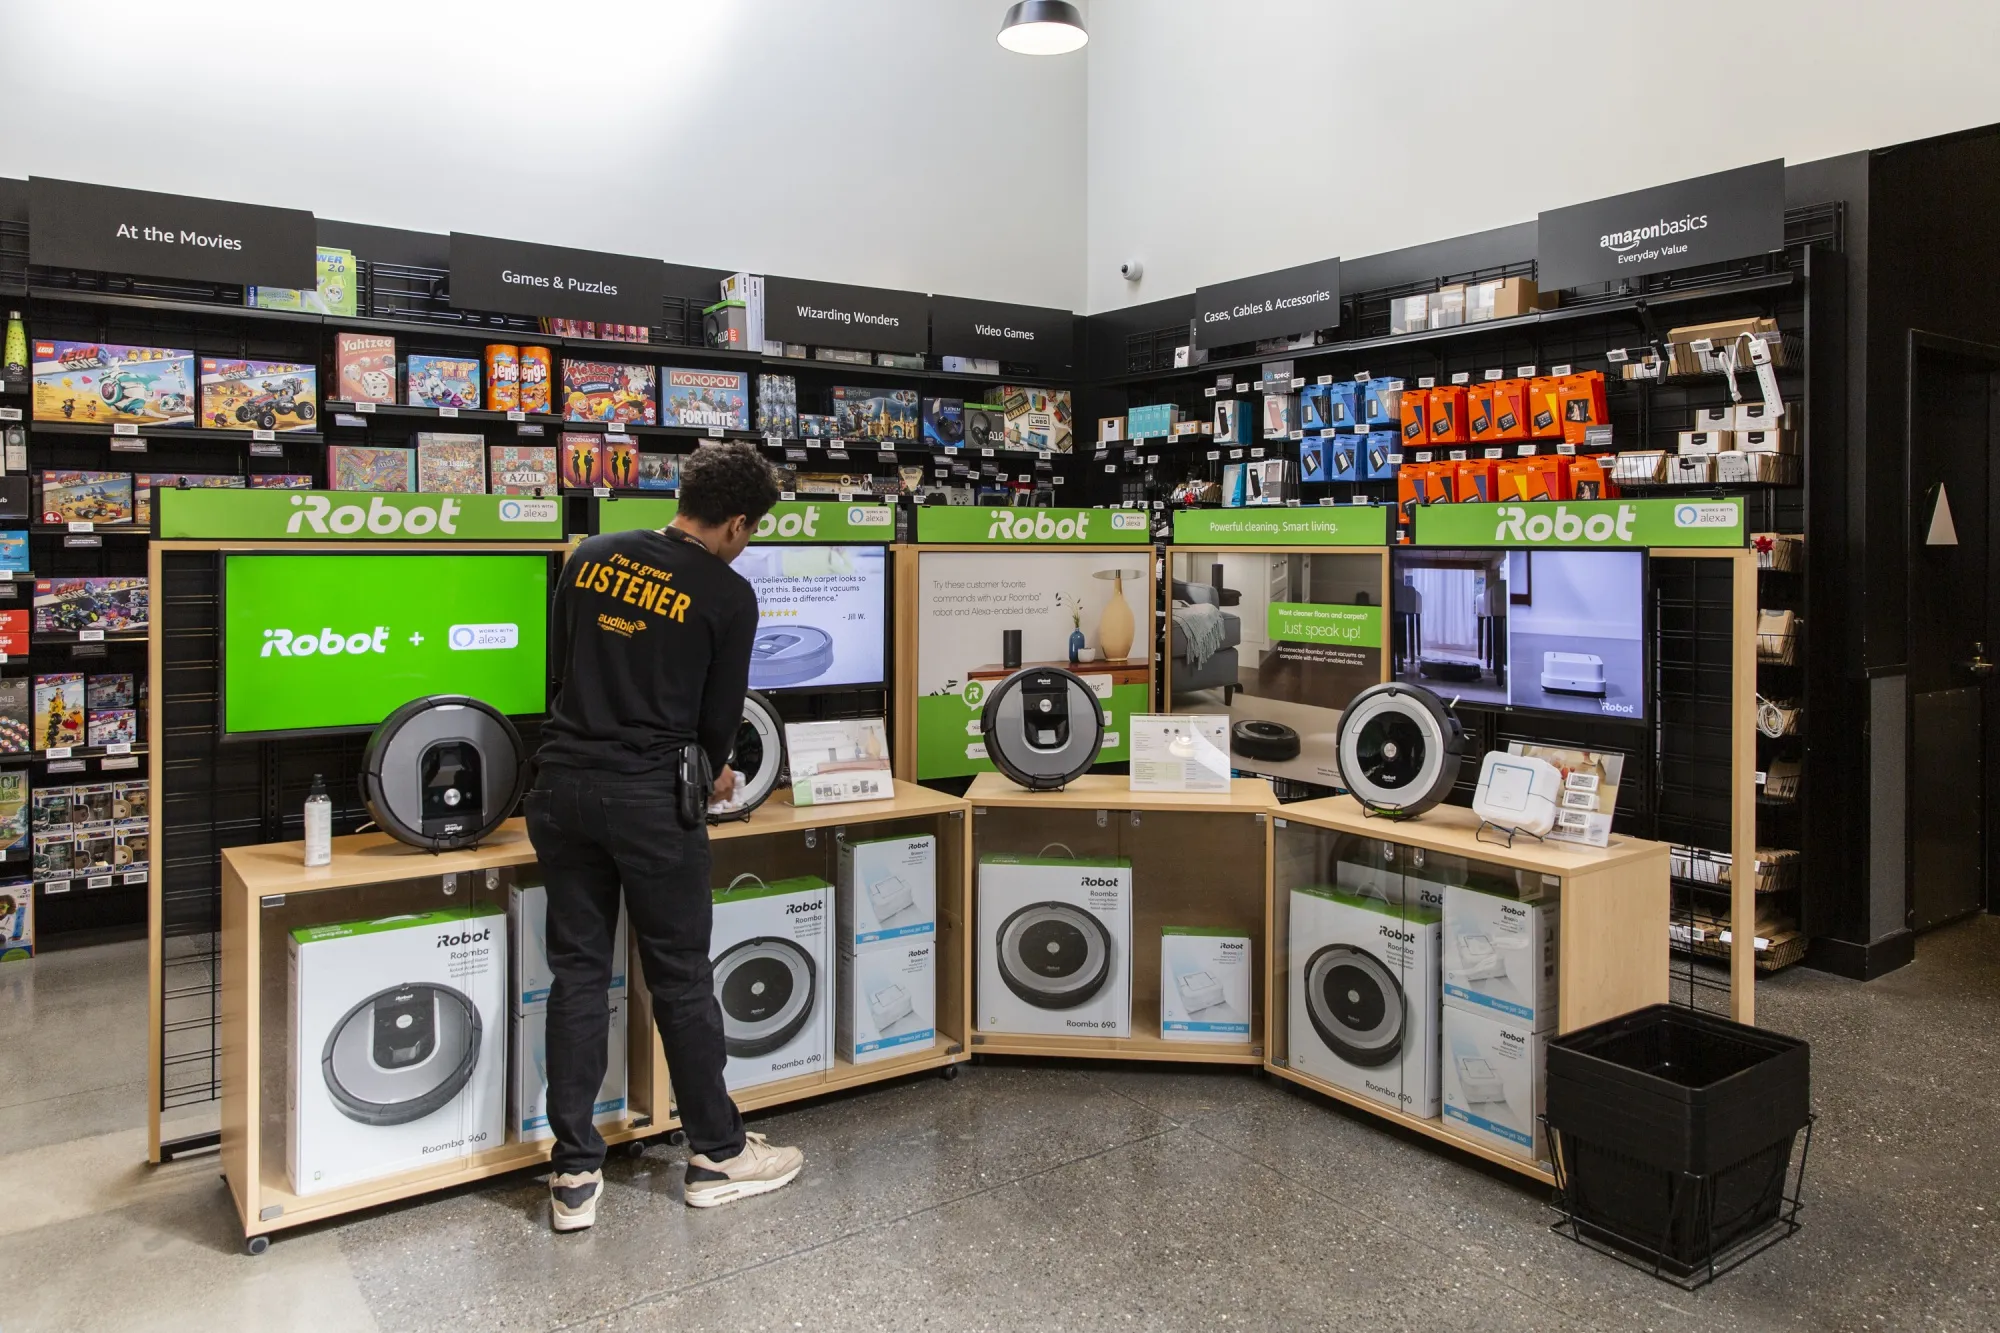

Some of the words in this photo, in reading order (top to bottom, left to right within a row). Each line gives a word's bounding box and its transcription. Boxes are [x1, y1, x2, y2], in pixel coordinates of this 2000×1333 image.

[116, 223, 139, 240] At
[143, 226, 175, 244] the
[180, 230, 242, 251] Movies
[1600, 214, 1708, 249] amazonbasics
[1618, 249, 1659, 264] Everyday
[1661, 244, 1688, 256] Value
[328, 264, 346, 273] 2.0
[502, 270, 549, 288] Games
[553, 276, 564, 289] &
[568, 278, 618, 296] Puzzles
[1204, 310, 1231, 324] Cases,
[1233, 302, 1263, 318] Cables
[1265, 300, 1273, 311] &
[1275, 289, 1330, 310] Accessories
[797, 305, 851, 325] Wizarding
[854, 312, 900, 327] Wonders
[975, 324, 1001, 337] Video
[1003, 327, 1035, 340] Games
[341, 338, 392, 351] Yahtzee
[58, 346, 99, 363] LEGO
[62, 358, 103, 371] MOVIE
[587, 363, 616, 375] Face
[573, 374, 614, 387] Cannon!
[671, 373, 739, 388] MONOPOLY
[1273, 371, 1290, 380] speck
[679, 409, 734, 426] FORTNITE
[566, 436, 600, 445] CODENAMES
[988, 431, 1004, 441] A10
[508, 473, 541, 483] AZUL
[286, 495, 461, 535] iRobot
[523, 509, 548, 518] alexa
[865, 512, 884, 522] alexa
[1700, 512, 1727, 523] alexa
[987, 509, 1090, 540] iRobot
[1125, 519, 1141, 527] alexa
[1209, 521, 1243, 532] Powerful
[1244, 521, 1280, 534] cleaning.
[1282, 521, 1310, 532] Smart
[1311, 521, 1338, 534] living.
[1495, 504, 1636, 541] iRobot
[608, 553, 631, 567] I'm
[630, 561, 639, 571] a
[638, 563, 673, 582] great
[753, 576, 801, 584] unbelievable.
[802, 575, 813, 585] My
[814, 575, 838, 585] carpet
[838, 574, 857, 583] looks
[932, 580, 944, 591] Try
[944, 580, 965, 589] these
[966, 580, 1000, 589] customer
[1001, 579, 1027, 588] favorite
[575, 561, 691, 623] LISTENER
[761, 587, 774, 596] got
[775, 586, 791, 594] this.
[792, 585, 822, 594] Because
[823, 584, 829, 592] it
[829, 584, 860, 592] vacuums
[769, 595, 791, 604] made
[932, 593, 976, 603] commands
[976, 593, 992, 602] with
[992, 594, 1008, 603] your
[932, 608, 953, 617] robot
[954, 607, 970, 616] and
[971, 605, 1024, 616] Alexa-enabled
[1024, 605, 1049, 615] device!
[1278, 608, 1293, 616] Want
[1293, 609, 1313, 617] cleaner
[1314, 610, 1330, 618] floors
[1330, 611, 1343, 619] and
[1343, 612, 1369, 622] carpets?
[598, 613, 635, 634] audible
[1282, 620, 1303, 635] Just
[1305, 623, 1340, 640] speak
[1342, 625, 1361, 642] up!
[260, 626, 390, 658] iRobot
[478, 633, 507, 644] alexa
[1282, 646, 1305, 654] connected
[1279, 653, 1303, 661] compatible
[1345, 658, 1364, 666] devices.
[1601, 701, 1635, 714] iRobot
[908, 841, 929, 850] iRobot
[1080, 876, 1119, 887] iRobot
[786, 899, 823, 915] iRobot
[1500, 904, 1526, 918] iRobot
[795, 914, 822, 924] Roomba
[436, 927, 491, 949] iRobot
[1378, 924, 1416, 944] iRobot
[1220, 942, 1244, 950] iRobot
[450, 947, 489, 961] Roomba
[908, 948, 929, 958] iRobot
[1066, 1019, 1099, 1029] Roomba
[1100, 1019, 1117, 1029] 690
[1499, 1029, 1525, 1044] iRobot
[771, 1057, 805, 1072] Roomba
[806, 1053, 822, 1064] 690
[1365, 1079, 1396, 1099] Roomba
[422, 1138, 464, 1155] Roomba
[467, 1131, 488, 1143] 960
